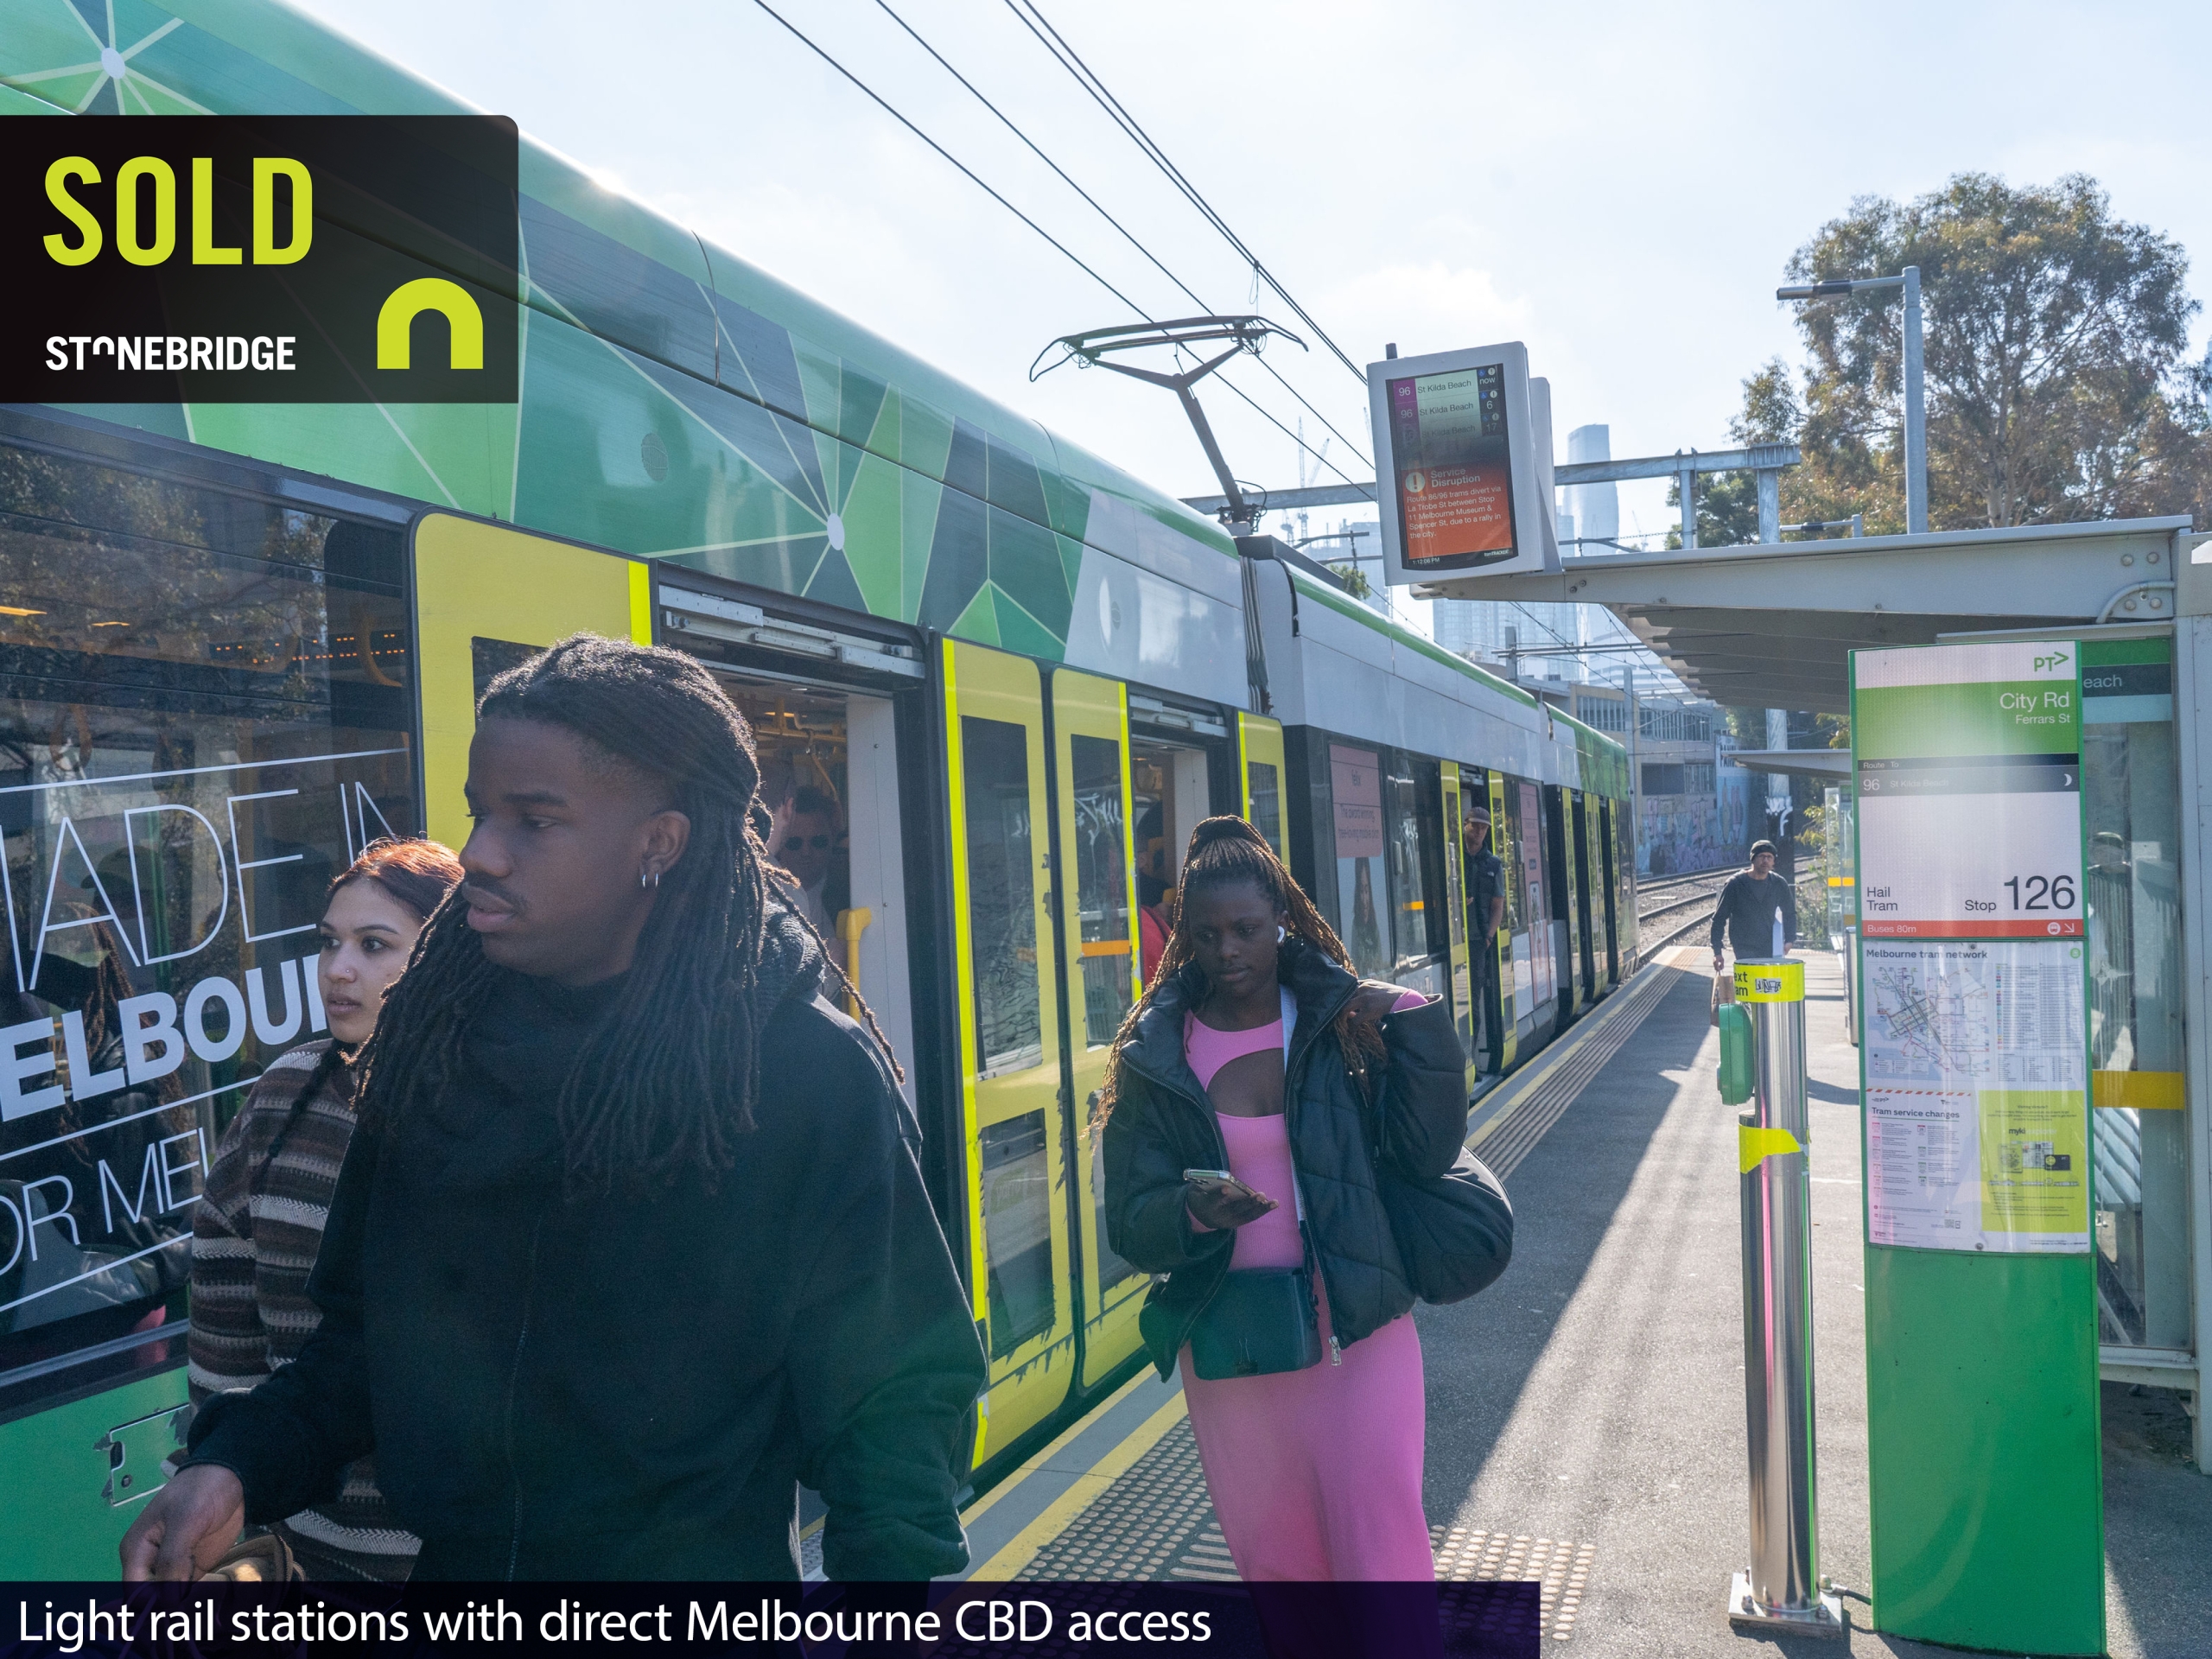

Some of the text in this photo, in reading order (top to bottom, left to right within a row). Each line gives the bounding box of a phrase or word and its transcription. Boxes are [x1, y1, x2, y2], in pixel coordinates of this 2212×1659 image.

[1398, 387, 1410, 396] 96
[1427, 383, 1446, 392] Kilda
[1448, 380, 1471, 389] Beach
[1479, 377, 1496, 385] now
[1401, 401, 1493, 418] 96 St Kilda Beach 6
[1431, 427, 1450, 436] Kilda
[1452, 425, 1476, 434] Beach
[1486, 423, 1497, 432] 17
[1431, 468, 1466, 479] Service
[1431, 475, 1481, 487] Disruption
[1427, 493, 1448, 501] 86/96
[1418, 502, 1437, 511] Trobe
[1448, 499, 1478, 507] between
[1478, 496, 1495, 505] Stop
[1419, 510, 1455, 520] Melbourne
[1456, 506, 1485, 515] Museum
[1408, 522, 1436, 531] Spencer
[1422, 531, 1436, 539] city.
[2083, 674, 2122, 688] each
[1999, 691, 2070, 712] City Rd
[2015, 714, 2070, 724] Ferrars St
[1863, 779, 1880, 791] 96
[1891, 779, 1899, 788] St
[1901, 779, 1921, 788] Kilda
[1866, 874, 2075, 912] Hail Stop 126
[1866, 900, 1898, 911] Tram
[1867, 925, 1916, 933] Buses 80m
[1866, 949, 1987, 959] Melbourne tram network
[1872, 1107, 1892, 1116] Tram
[1925, 1110, 1960, 1120] changes
